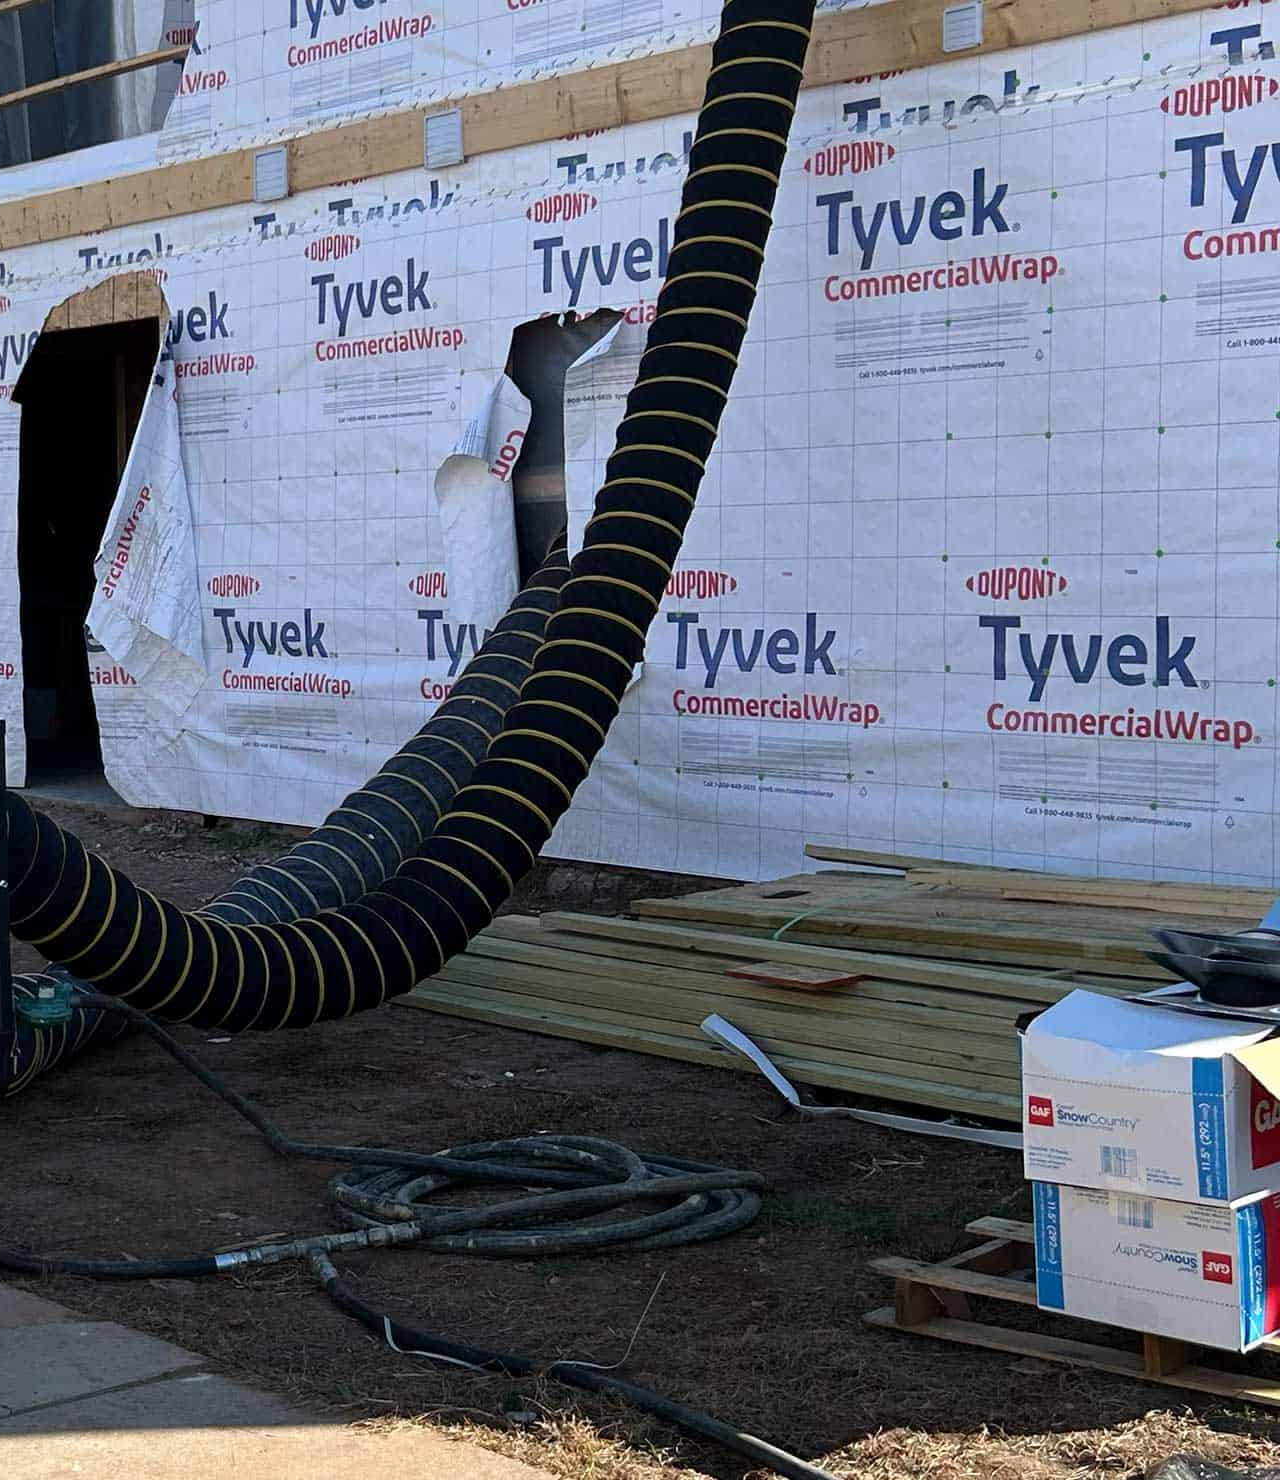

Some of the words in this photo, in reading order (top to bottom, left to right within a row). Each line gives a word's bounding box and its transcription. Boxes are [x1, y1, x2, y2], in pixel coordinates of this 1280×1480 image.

[287, 14, 432, 68] CommercialWrap
[1174, 76, 1266, 118] DUPONT
[815, 141, 884, 177] DUPONT
[535, 193, 588, 224] DUPONT
[816, 168, 1010, 271] Tyvek
[310, 235, 355, 262] DUPONT
[825, 253, 1058, 302] CommercialWrap
[311, 257, 430, 337] Tyvek
[167, 290, 230, 348] vek
[315, 326, 463, 362] CommercialWrap
[176, 353, 255, 378] ercialWrap
[213, 576, 255, 598] DUPONT
[977, 568, 1057, 601] DUPONT
[213, 608, 328, 669] Tyvek
[666, 612, 837, 689] Tyvek
[979, 616, 1197, 701] Tyvek
[223, 669, 352, 698] CommercialWrap
[673, 690, 879, 728] CommercialWrap
[986, 704, 1253, 749] CommercialWrap
[1030, 1104, 1051, 1118] GAF
[1204, 1261, 1231, 1275] GAF
